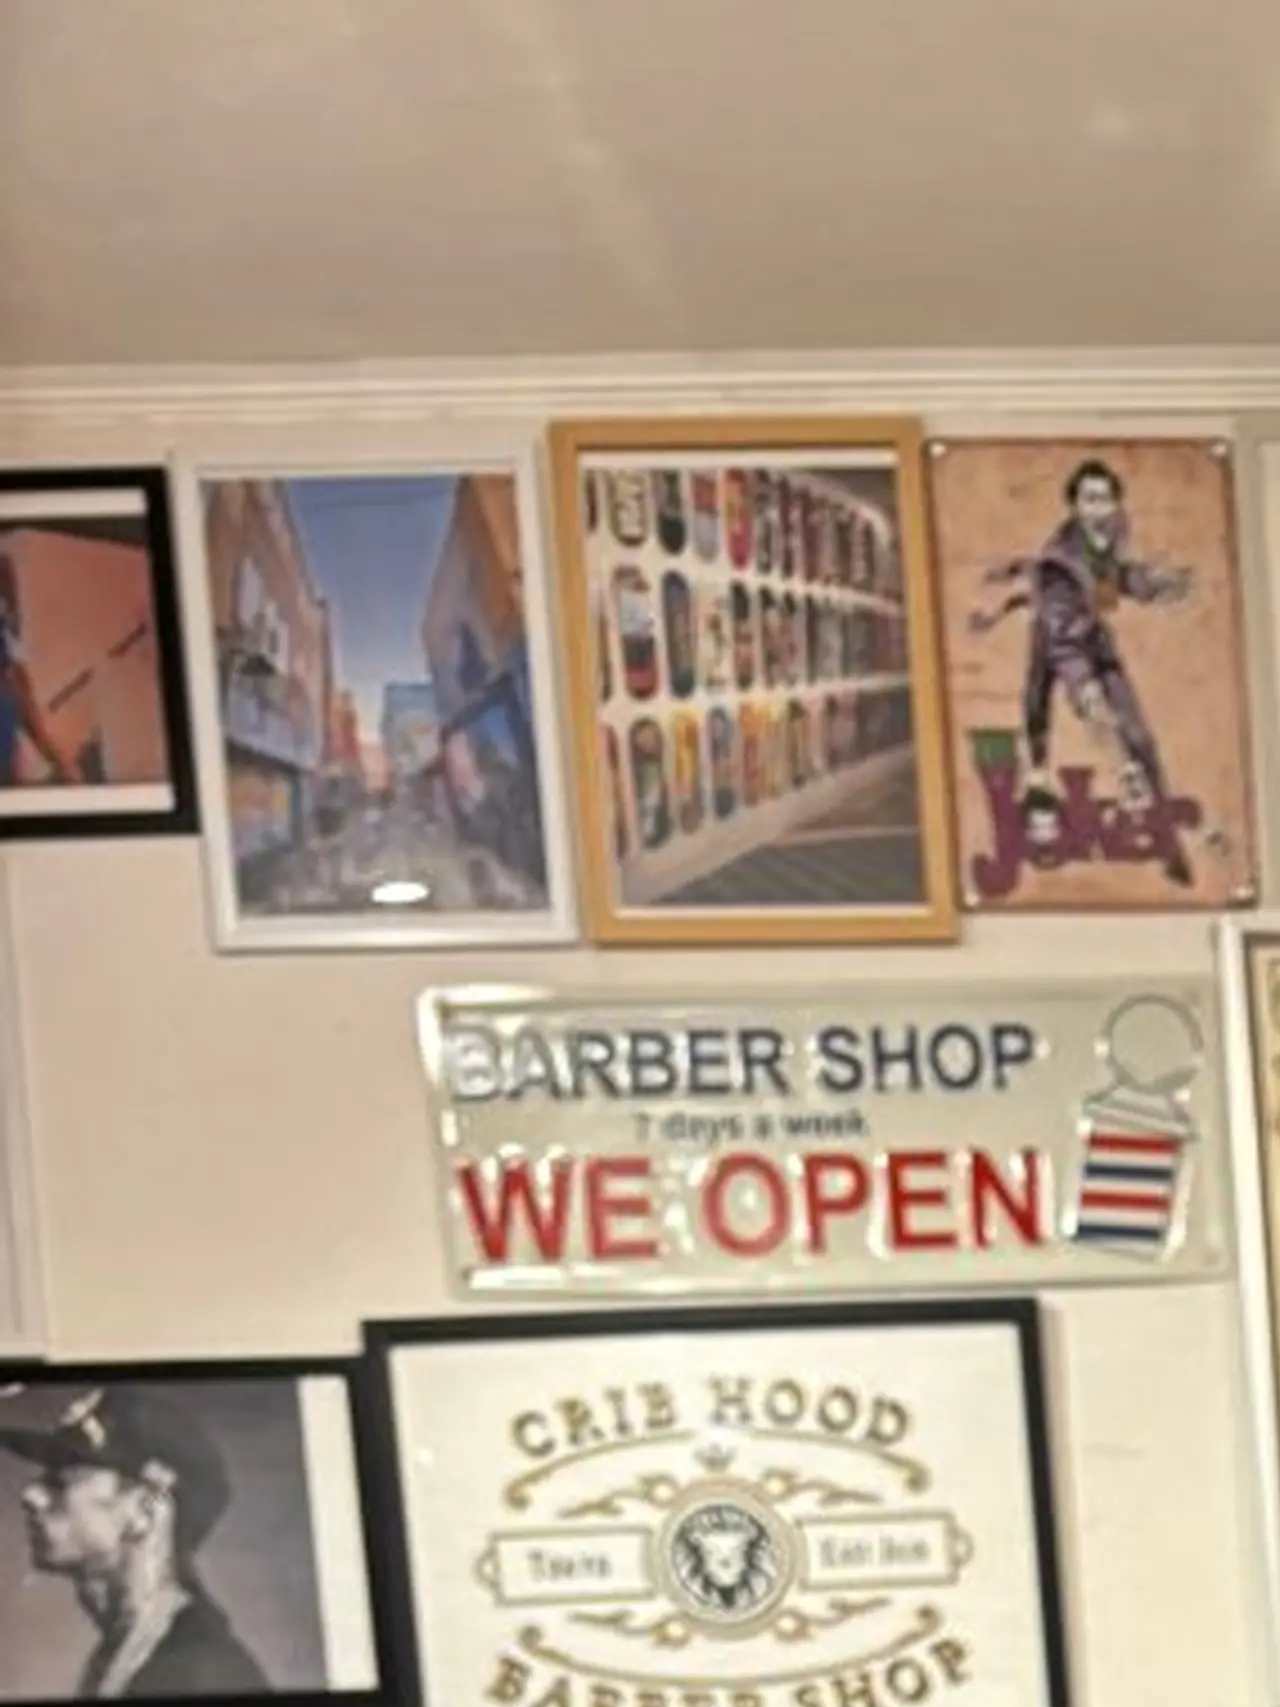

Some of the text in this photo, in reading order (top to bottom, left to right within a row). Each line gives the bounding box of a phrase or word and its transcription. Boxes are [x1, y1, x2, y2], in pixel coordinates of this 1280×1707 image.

[443, 1022, 1035, 1102] BARBER SHOP
[660, 1110, 744, 1150] days
[782, 1106, 869, 1141] week
[453, 1145, 1045, 1267] WE OPEN
[510, 1376, 910, 1459] CRIB HOOD
